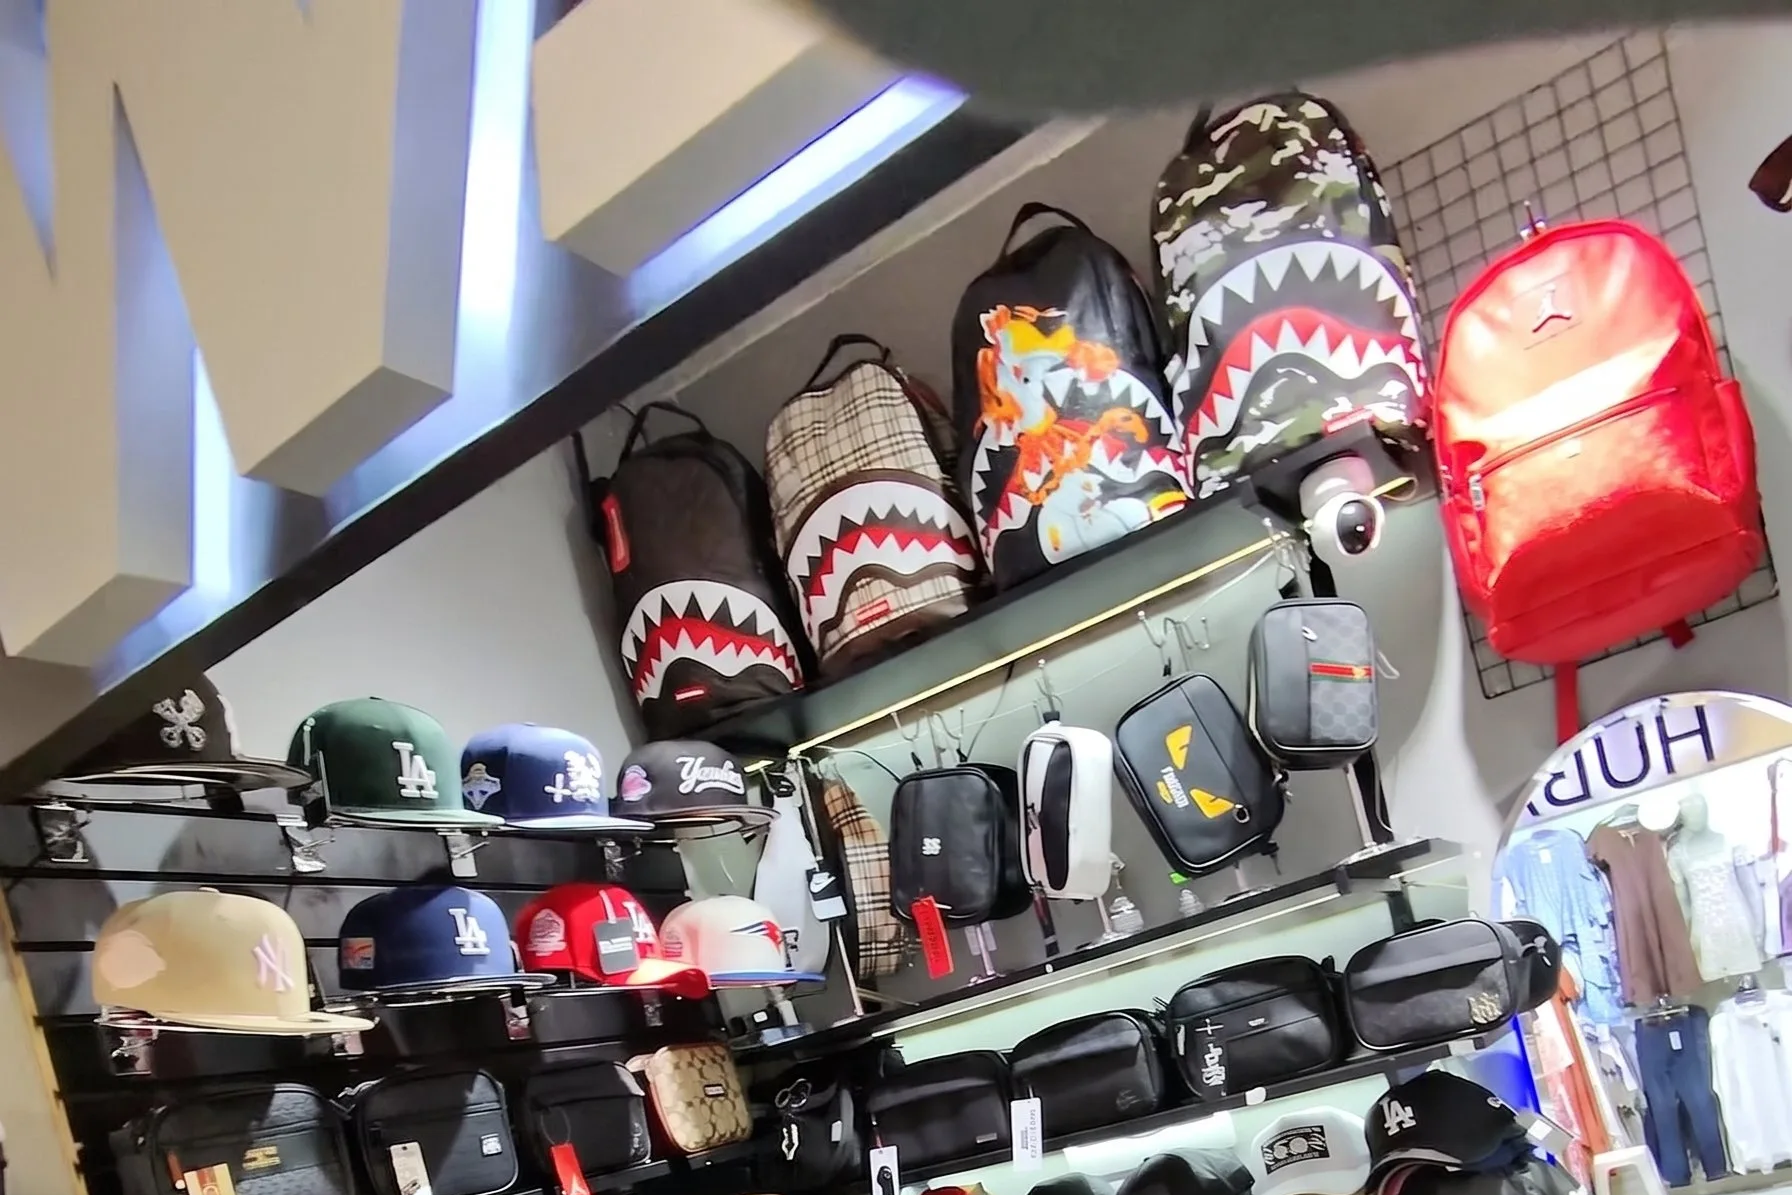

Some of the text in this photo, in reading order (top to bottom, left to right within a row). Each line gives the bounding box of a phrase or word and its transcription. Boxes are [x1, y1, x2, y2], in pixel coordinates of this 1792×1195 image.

[392, 740, 439, 799] LA
[449, 907, 491, 956] LA
[1383, 1097, 1417, 1137] LA
